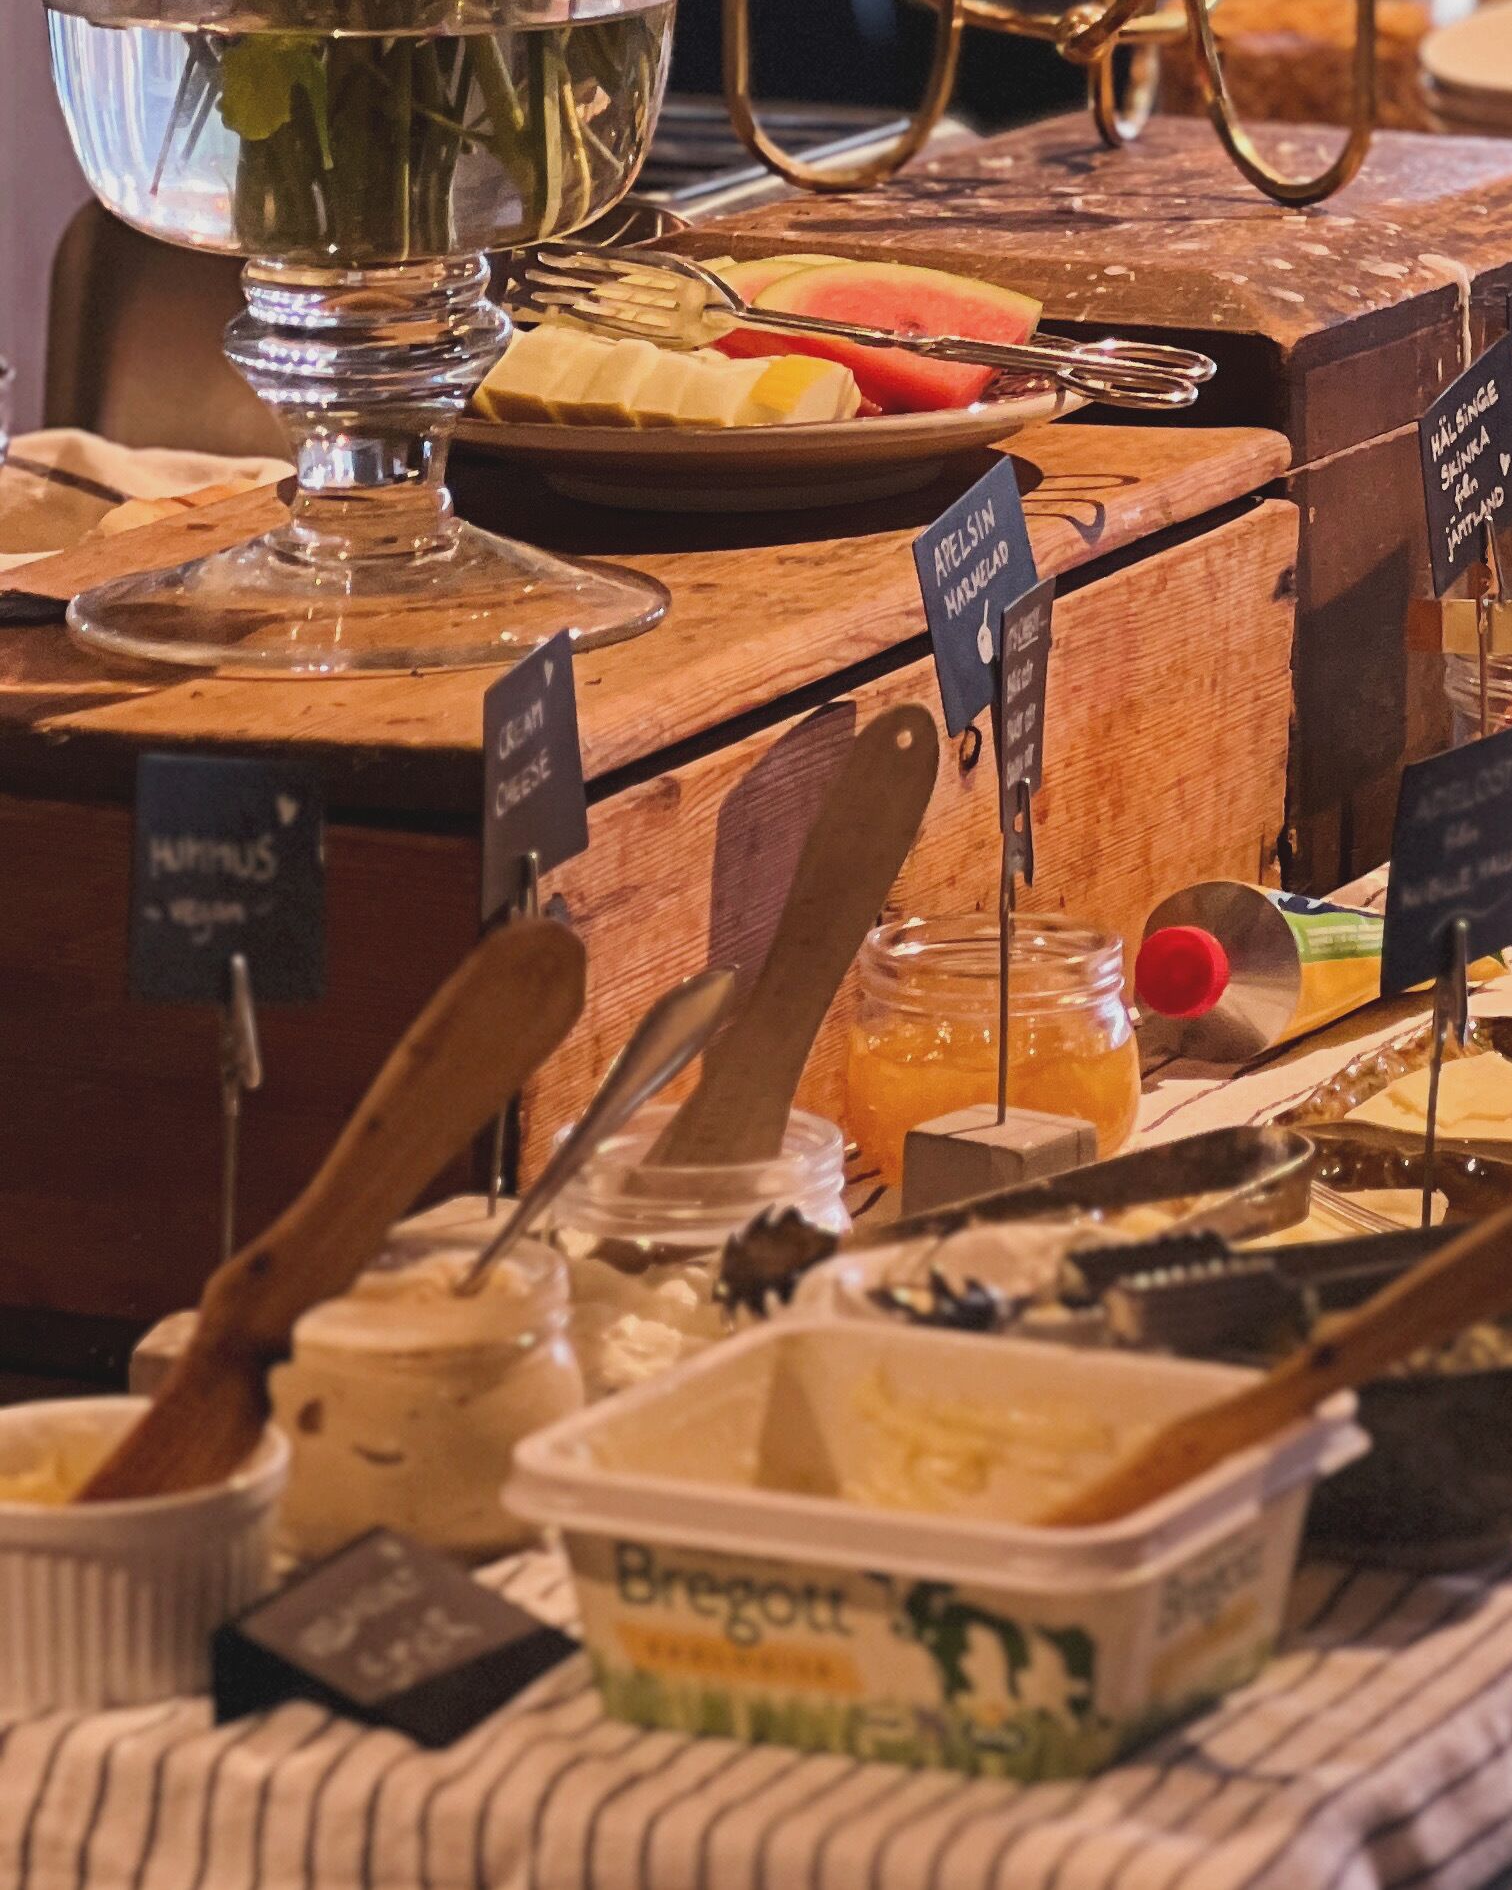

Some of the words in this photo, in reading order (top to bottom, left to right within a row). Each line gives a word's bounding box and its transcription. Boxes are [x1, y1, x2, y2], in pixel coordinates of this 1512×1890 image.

[934, 498, 996, 588] APELSIN
[943, 540, 1009, 620] MARMELAD
[614, 1539, 853, 1648] Bregott
